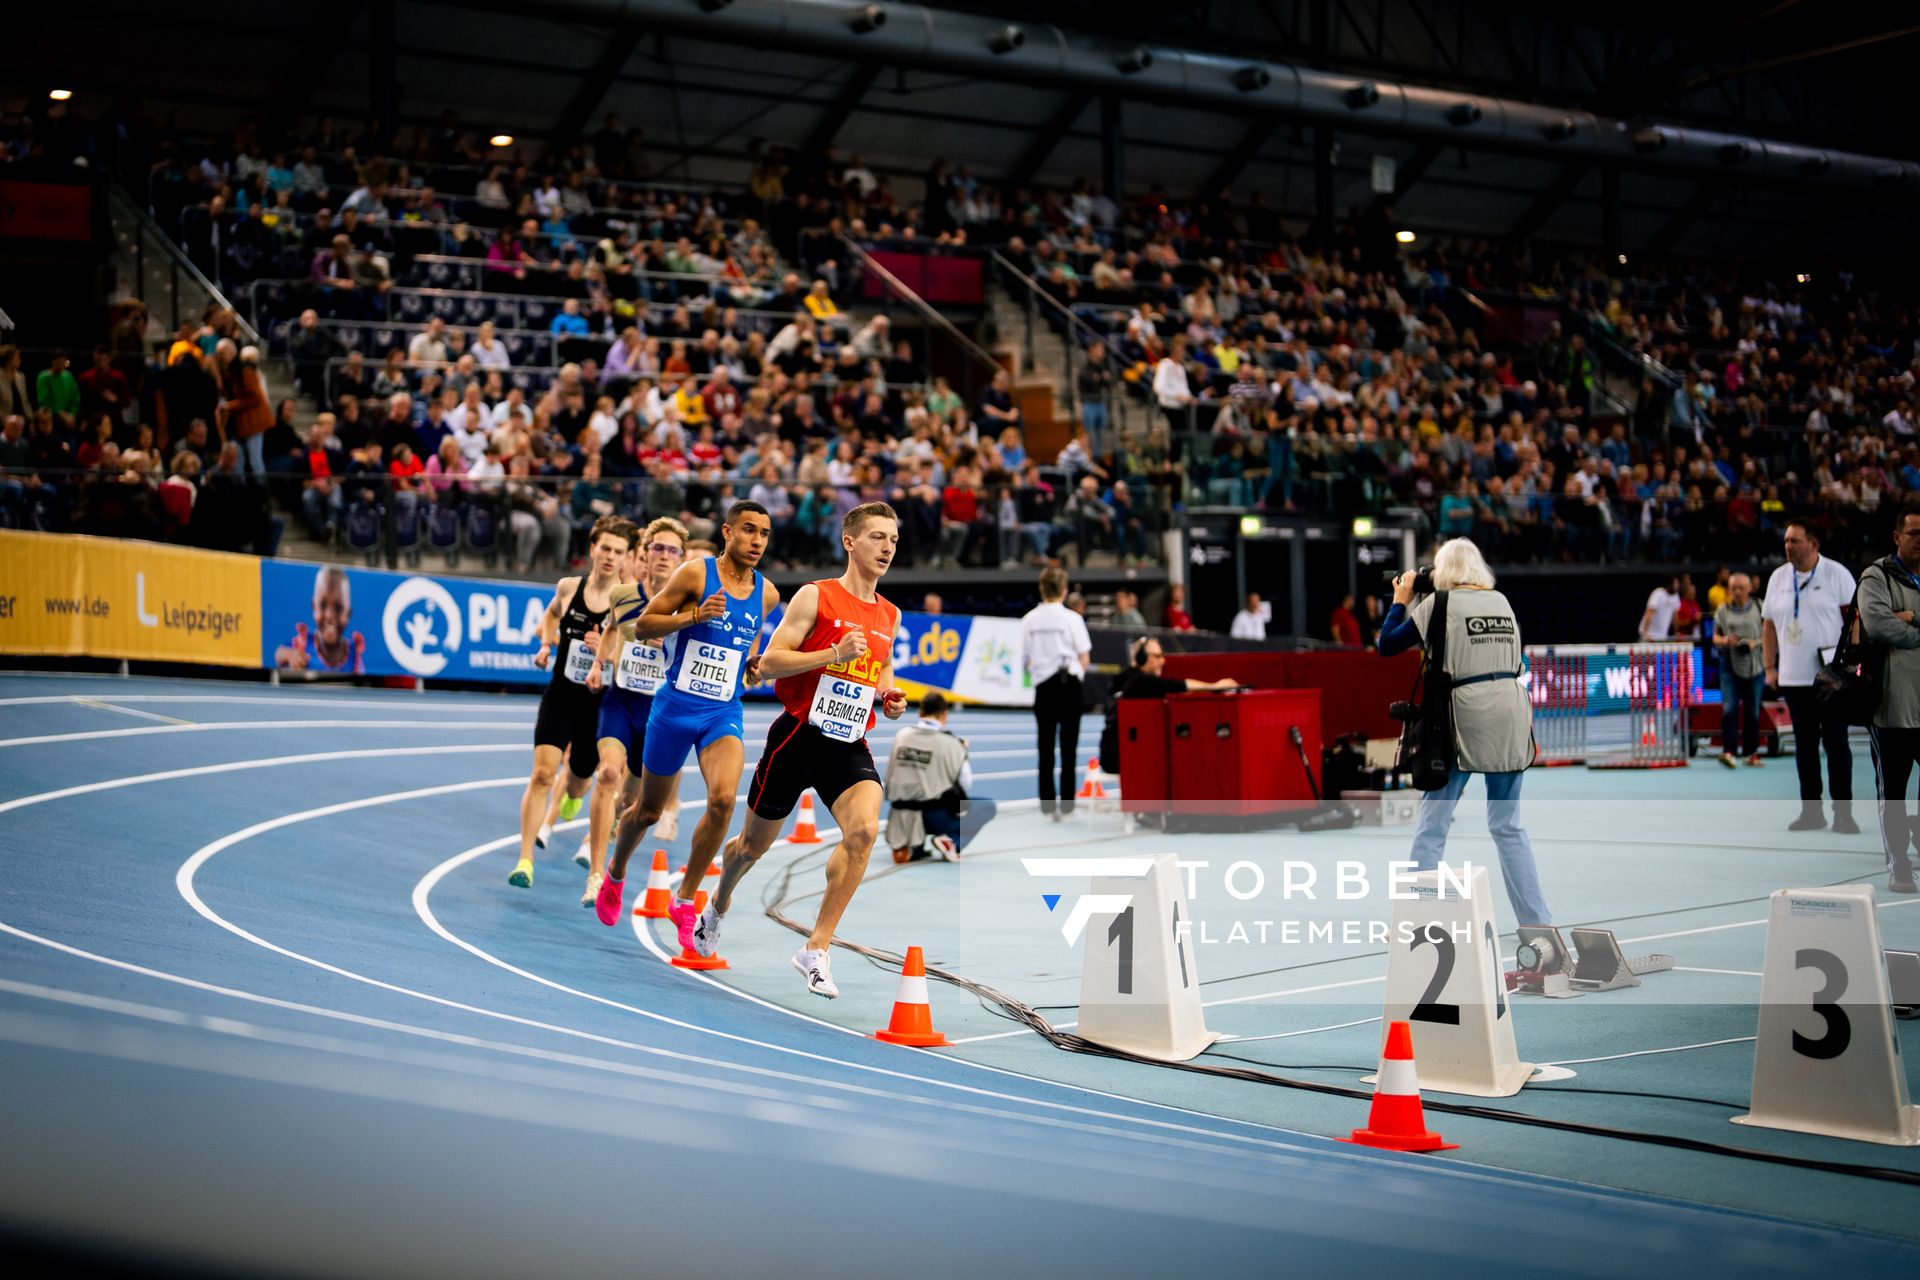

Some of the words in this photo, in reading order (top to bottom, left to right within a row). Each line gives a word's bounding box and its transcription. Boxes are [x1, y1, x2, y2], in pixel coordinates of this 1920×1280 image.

[163, 599, 242, 639] Leipziger
[1487, 618, 1513, 629] PLAN
[632, 646, 657, 660] GLS
[698, 645, 727, 662] GLS
[690, 660, 728, 683] ZITTEL
[832, 681, 862, 700] GLS
[815, 696, 867, 724] A.BEIMLER
[1108, 906, 1133, 995] 1
[1410, 925, 1460, 1025] 2
[1792, 948, 1851, 1060] 3
